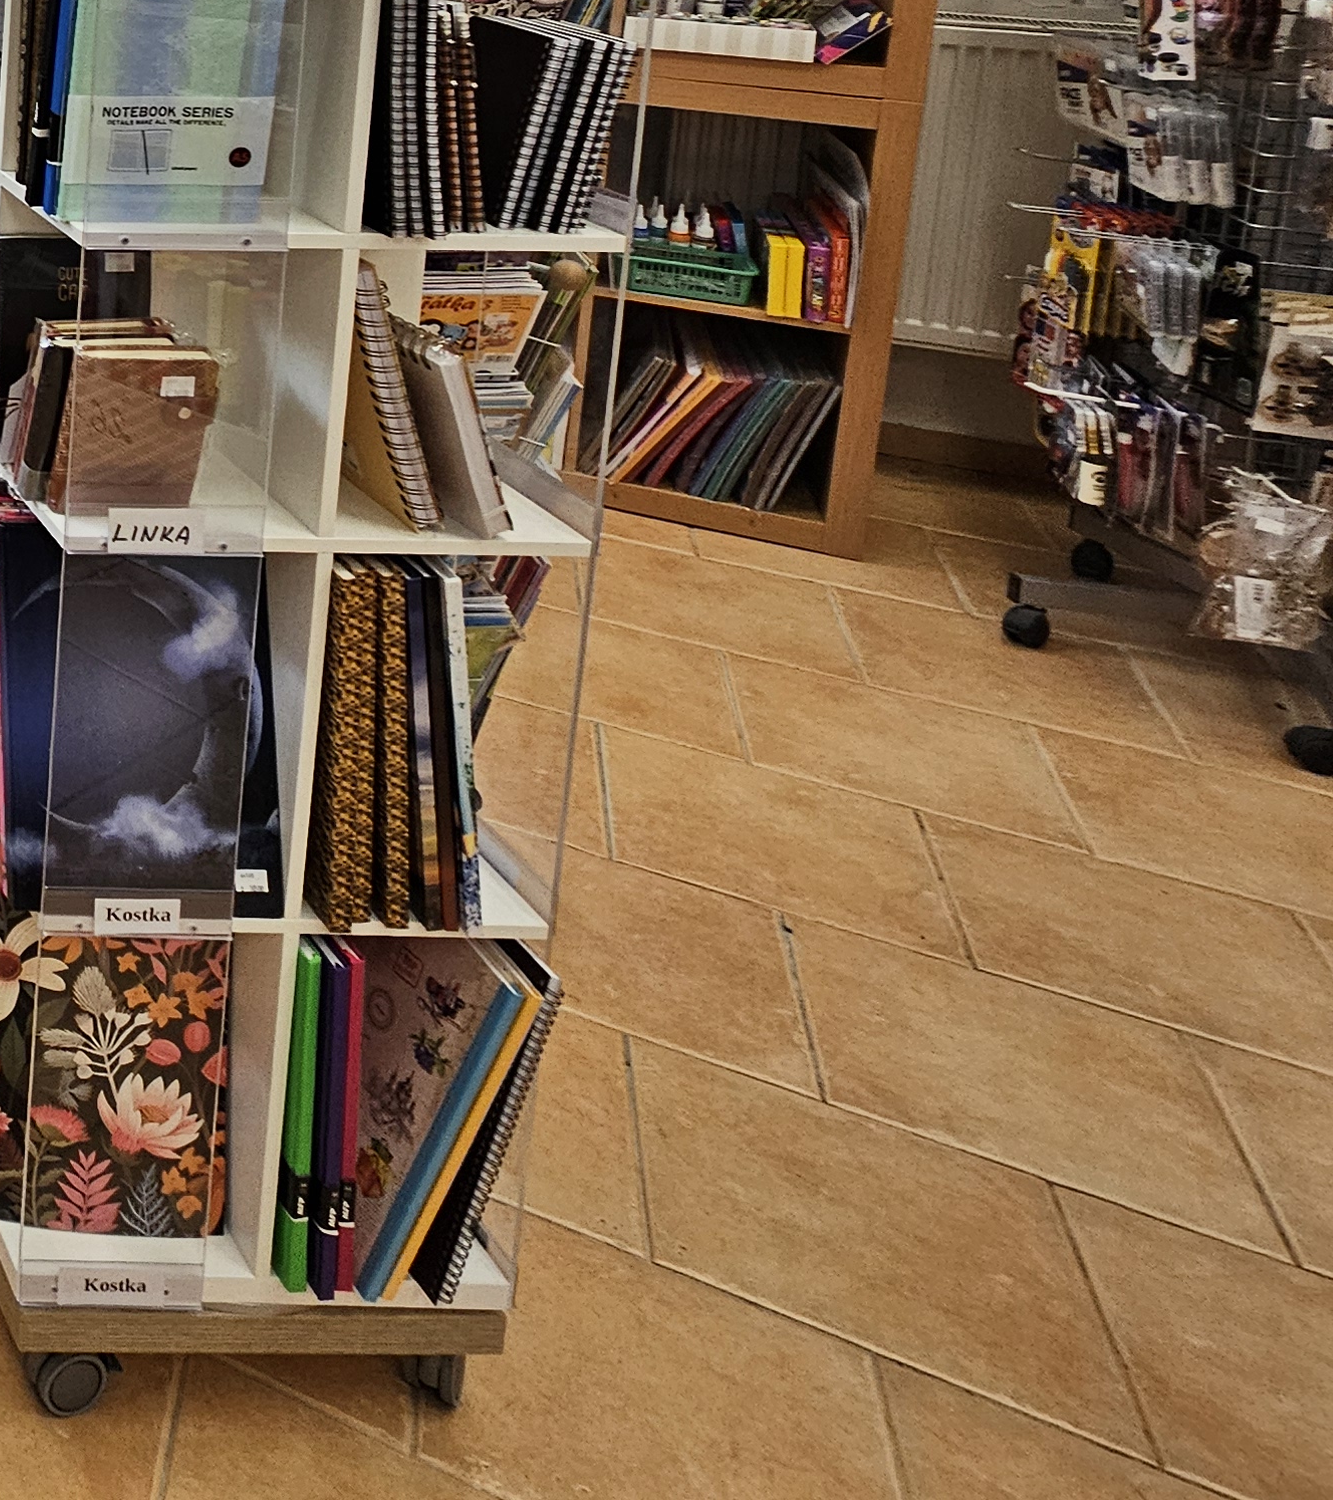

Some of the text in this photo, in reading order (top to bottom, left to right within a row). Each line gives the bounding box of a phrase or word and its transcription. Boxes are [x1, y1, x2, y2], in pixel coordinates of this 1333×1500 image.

[102, 106, 235, 119] NOTEBOOK SERIES
[112, 524, 191, 545] LINKA
[105, 906, 172, 925] Kostka
[83, 1275, 147, 1296] Kostka
